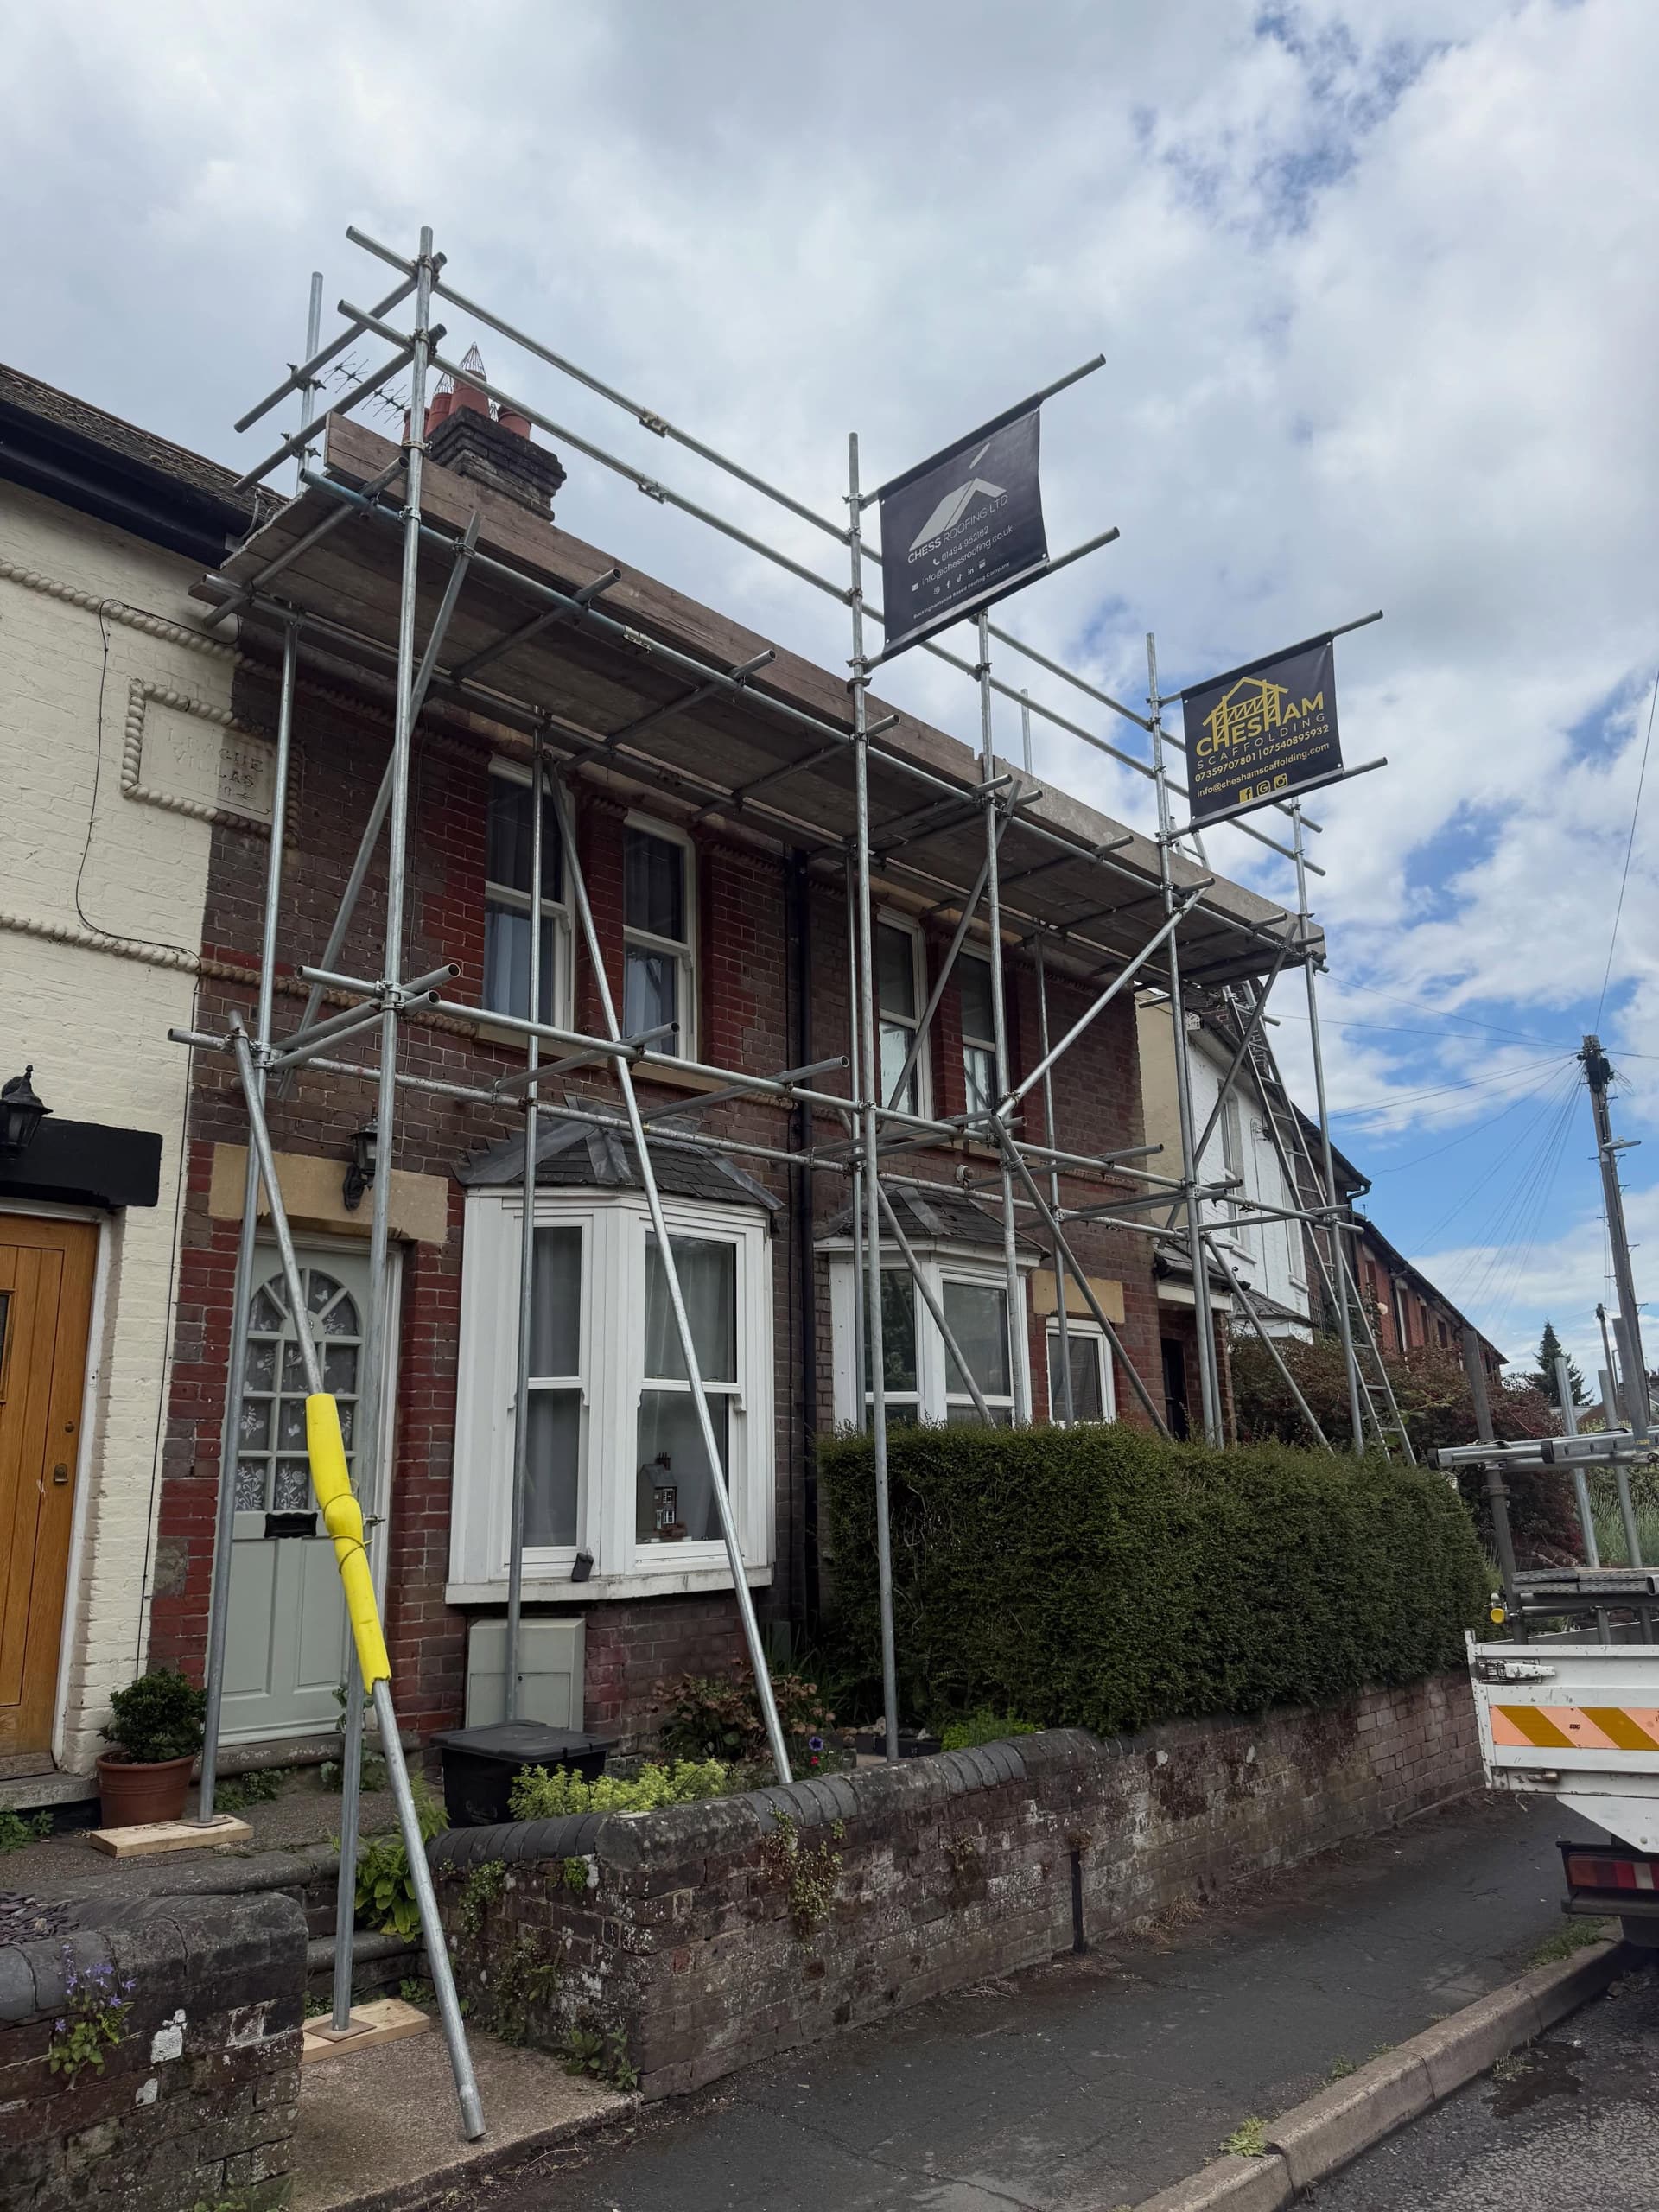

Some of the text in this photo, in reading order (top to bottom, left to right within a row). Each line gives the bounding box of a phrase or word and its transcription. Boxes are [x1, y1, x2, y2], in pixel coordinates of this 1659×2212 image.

[907, 494, 1009, 563] CHESS ROOFING LTD
[921, 524, 1014, 586] info@chessroofing.co.uk
[941, 543, 963, 562] 01494
[1194, 753, 1256, 783] 07359707801
[1262, 723, 1330, 757] 07540895932
[1196, 690, 1325, 757] CHESHAM
[1197, 712, 1325, 771] SCAFFOLDING
[1197, 742, 1331, 798] info@cheshamscaffolding.com
